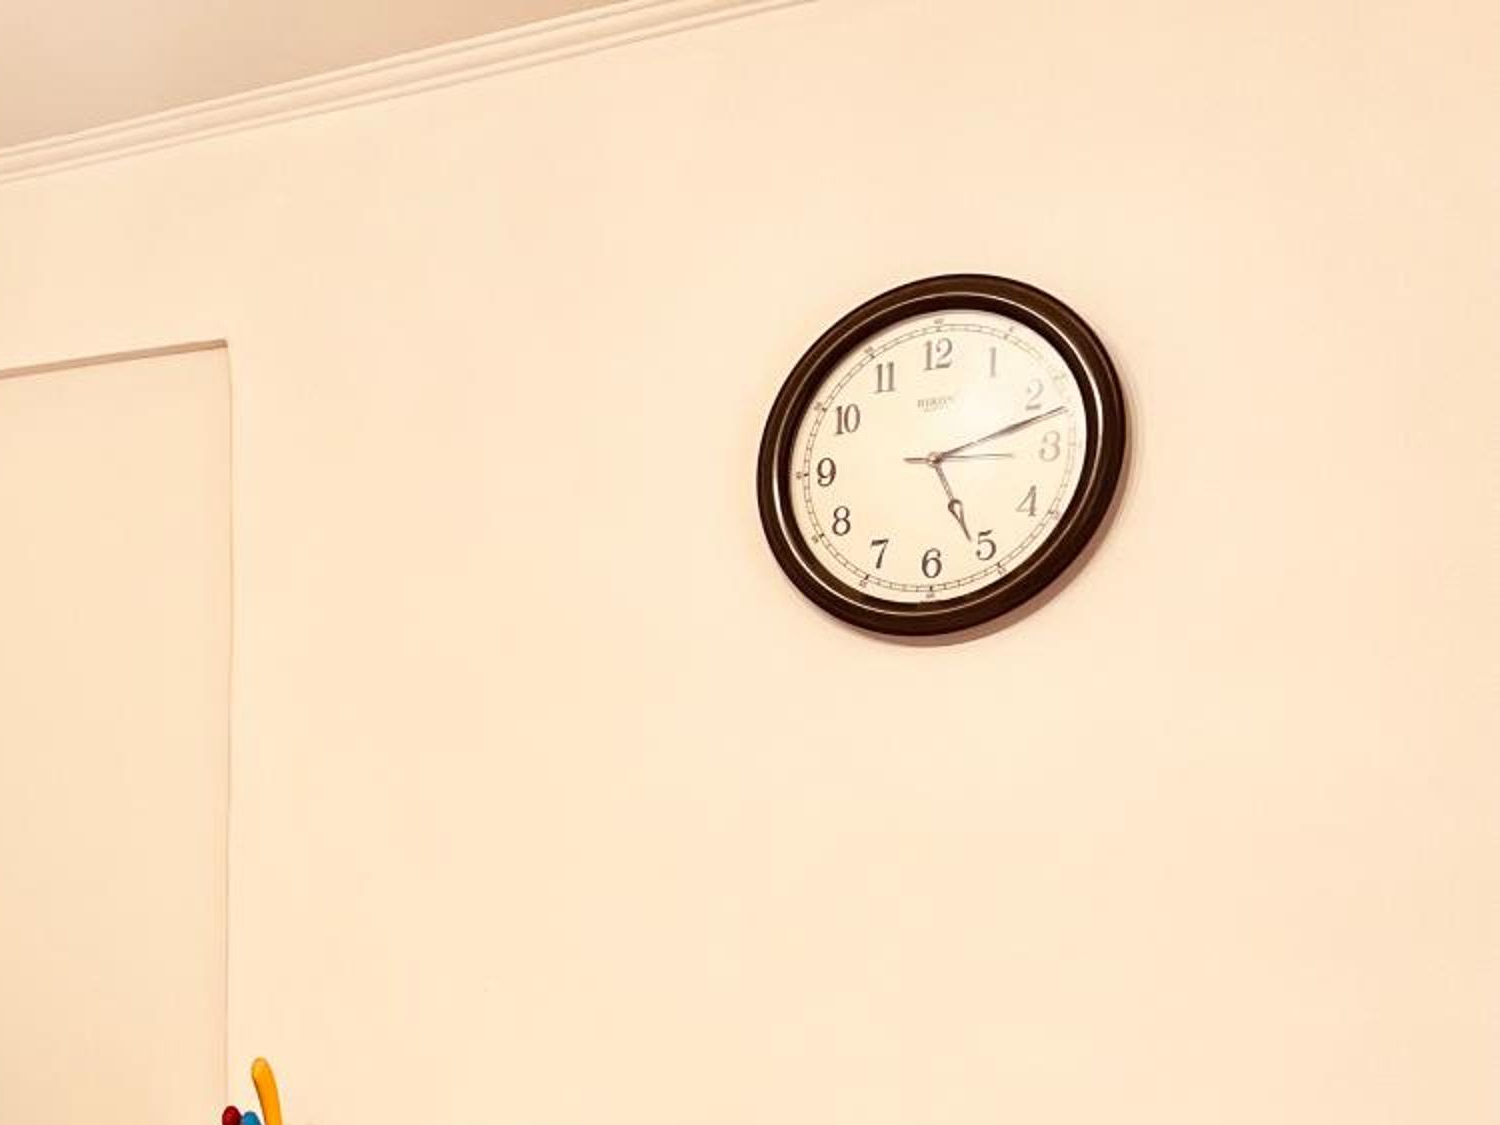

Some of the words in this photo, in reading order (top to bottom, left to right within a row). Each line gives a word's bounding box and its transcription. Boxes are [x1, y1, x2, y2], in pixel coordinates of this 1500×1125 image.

[923, 337, 953, 371] 12
[987, 346, 997, 378] 1
[873, 361, 896, 394] 11
[1024, 380, 1044, 411] 2
[834, 403, 861, 435] 10
[1039, 430, 1061, 462] 3
[816, 458, 837, 487] 9
[1016, 486, 1037, 517] 4
[832, 506, 851, 537] 8
[870, 539, 889, 569] 7
[975, 530, 997, 561] 5
[921, 548, 942, 578] 6
